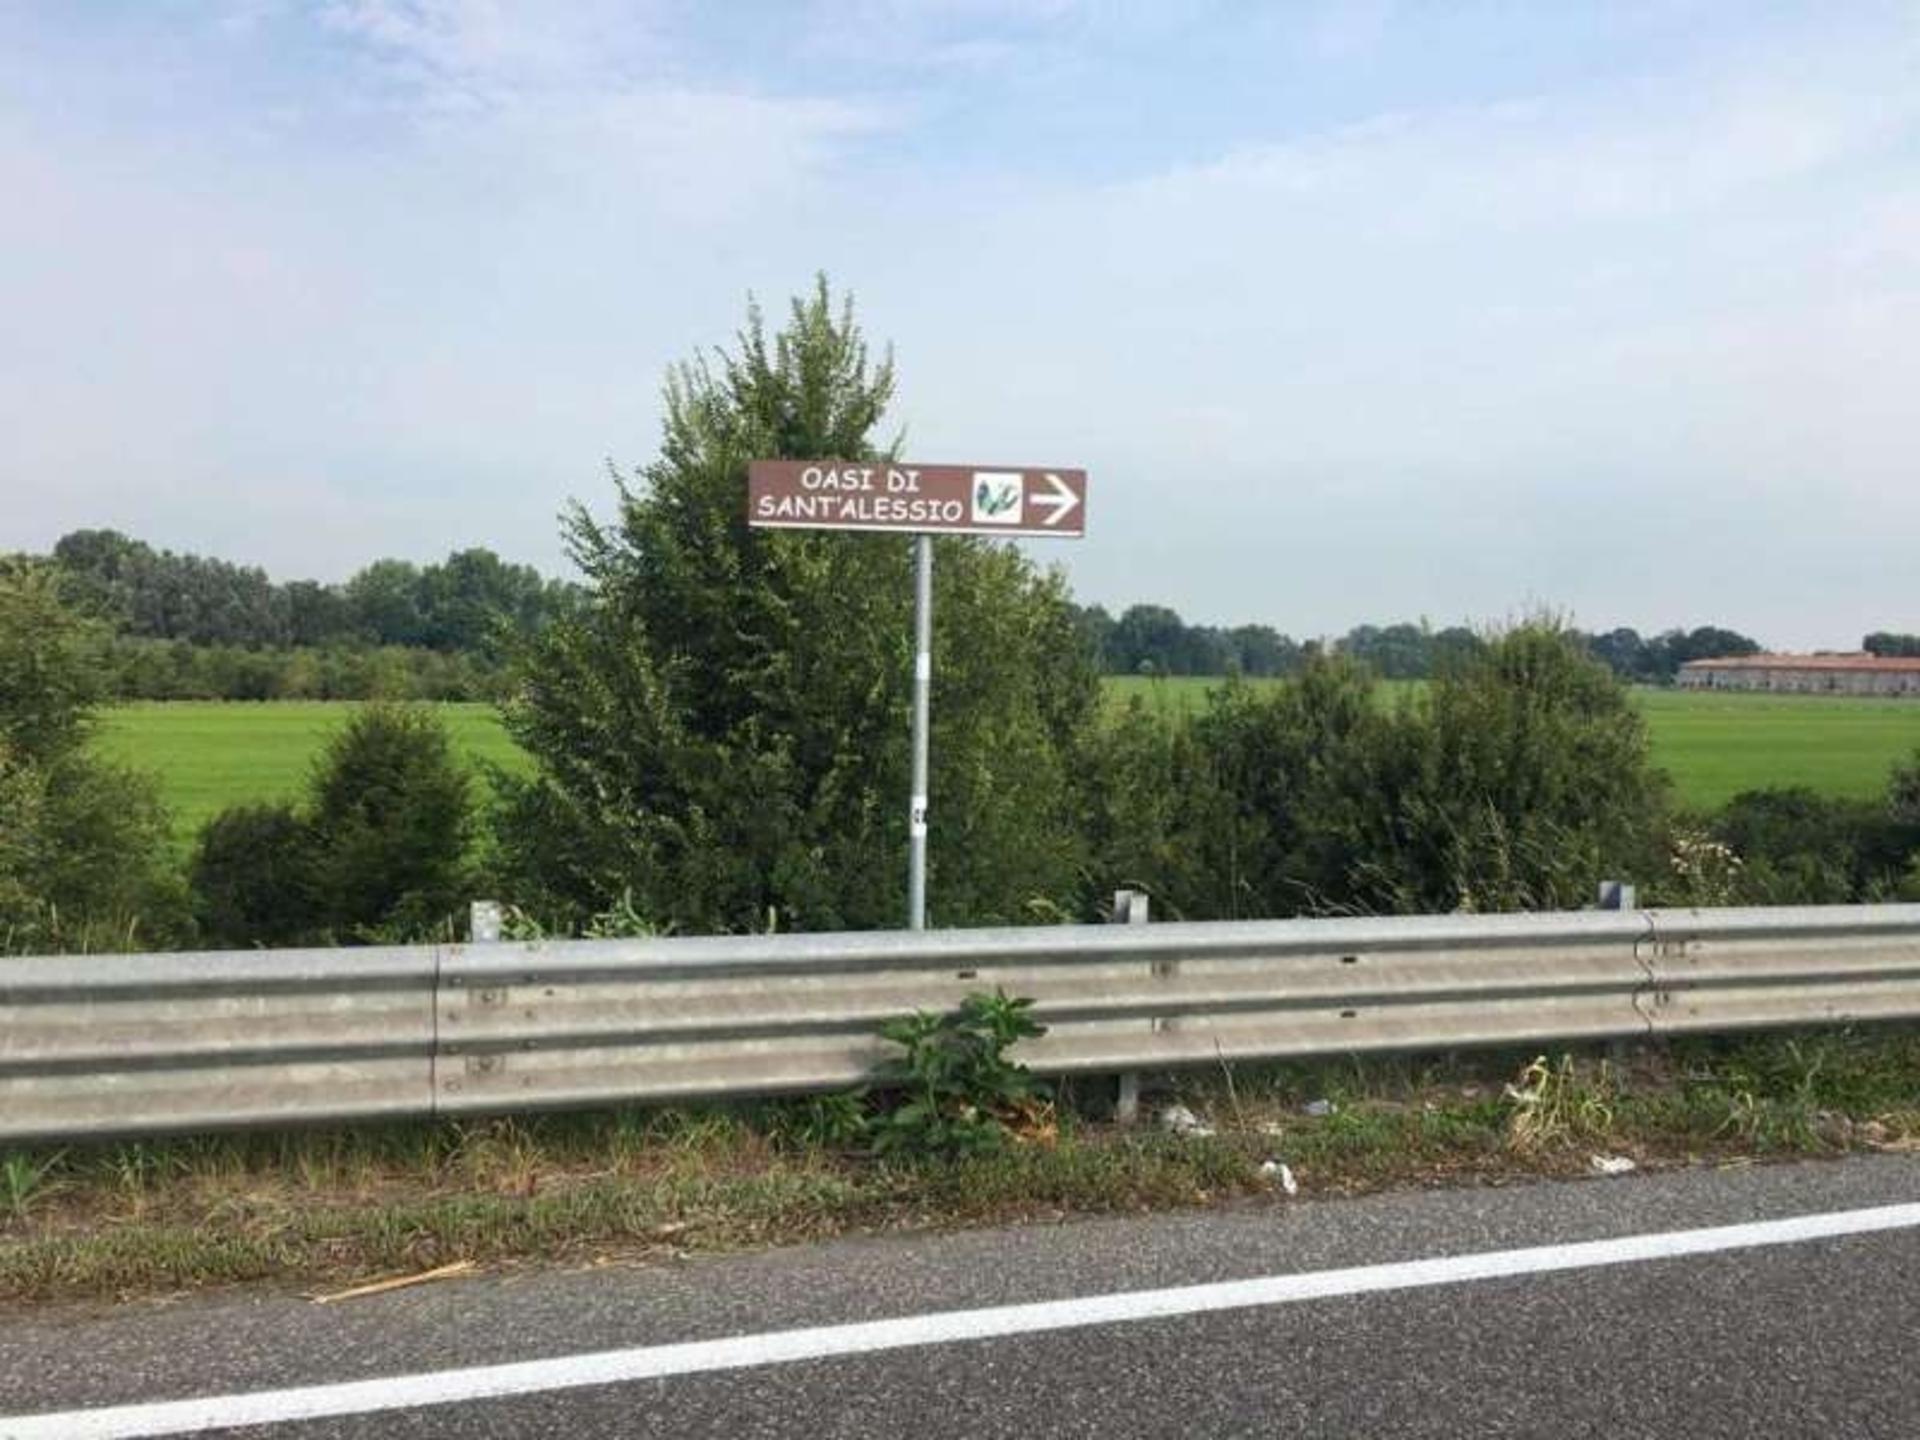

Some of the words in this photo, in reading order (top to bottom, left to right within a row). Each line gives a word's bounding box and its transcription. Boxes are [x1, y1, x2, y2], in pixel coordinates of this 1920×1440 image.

[801, 467, 875, 490] OASI
[887, 469, 920, 492] DI
[757, 496, 963, 522] SANT'ALESSIO
